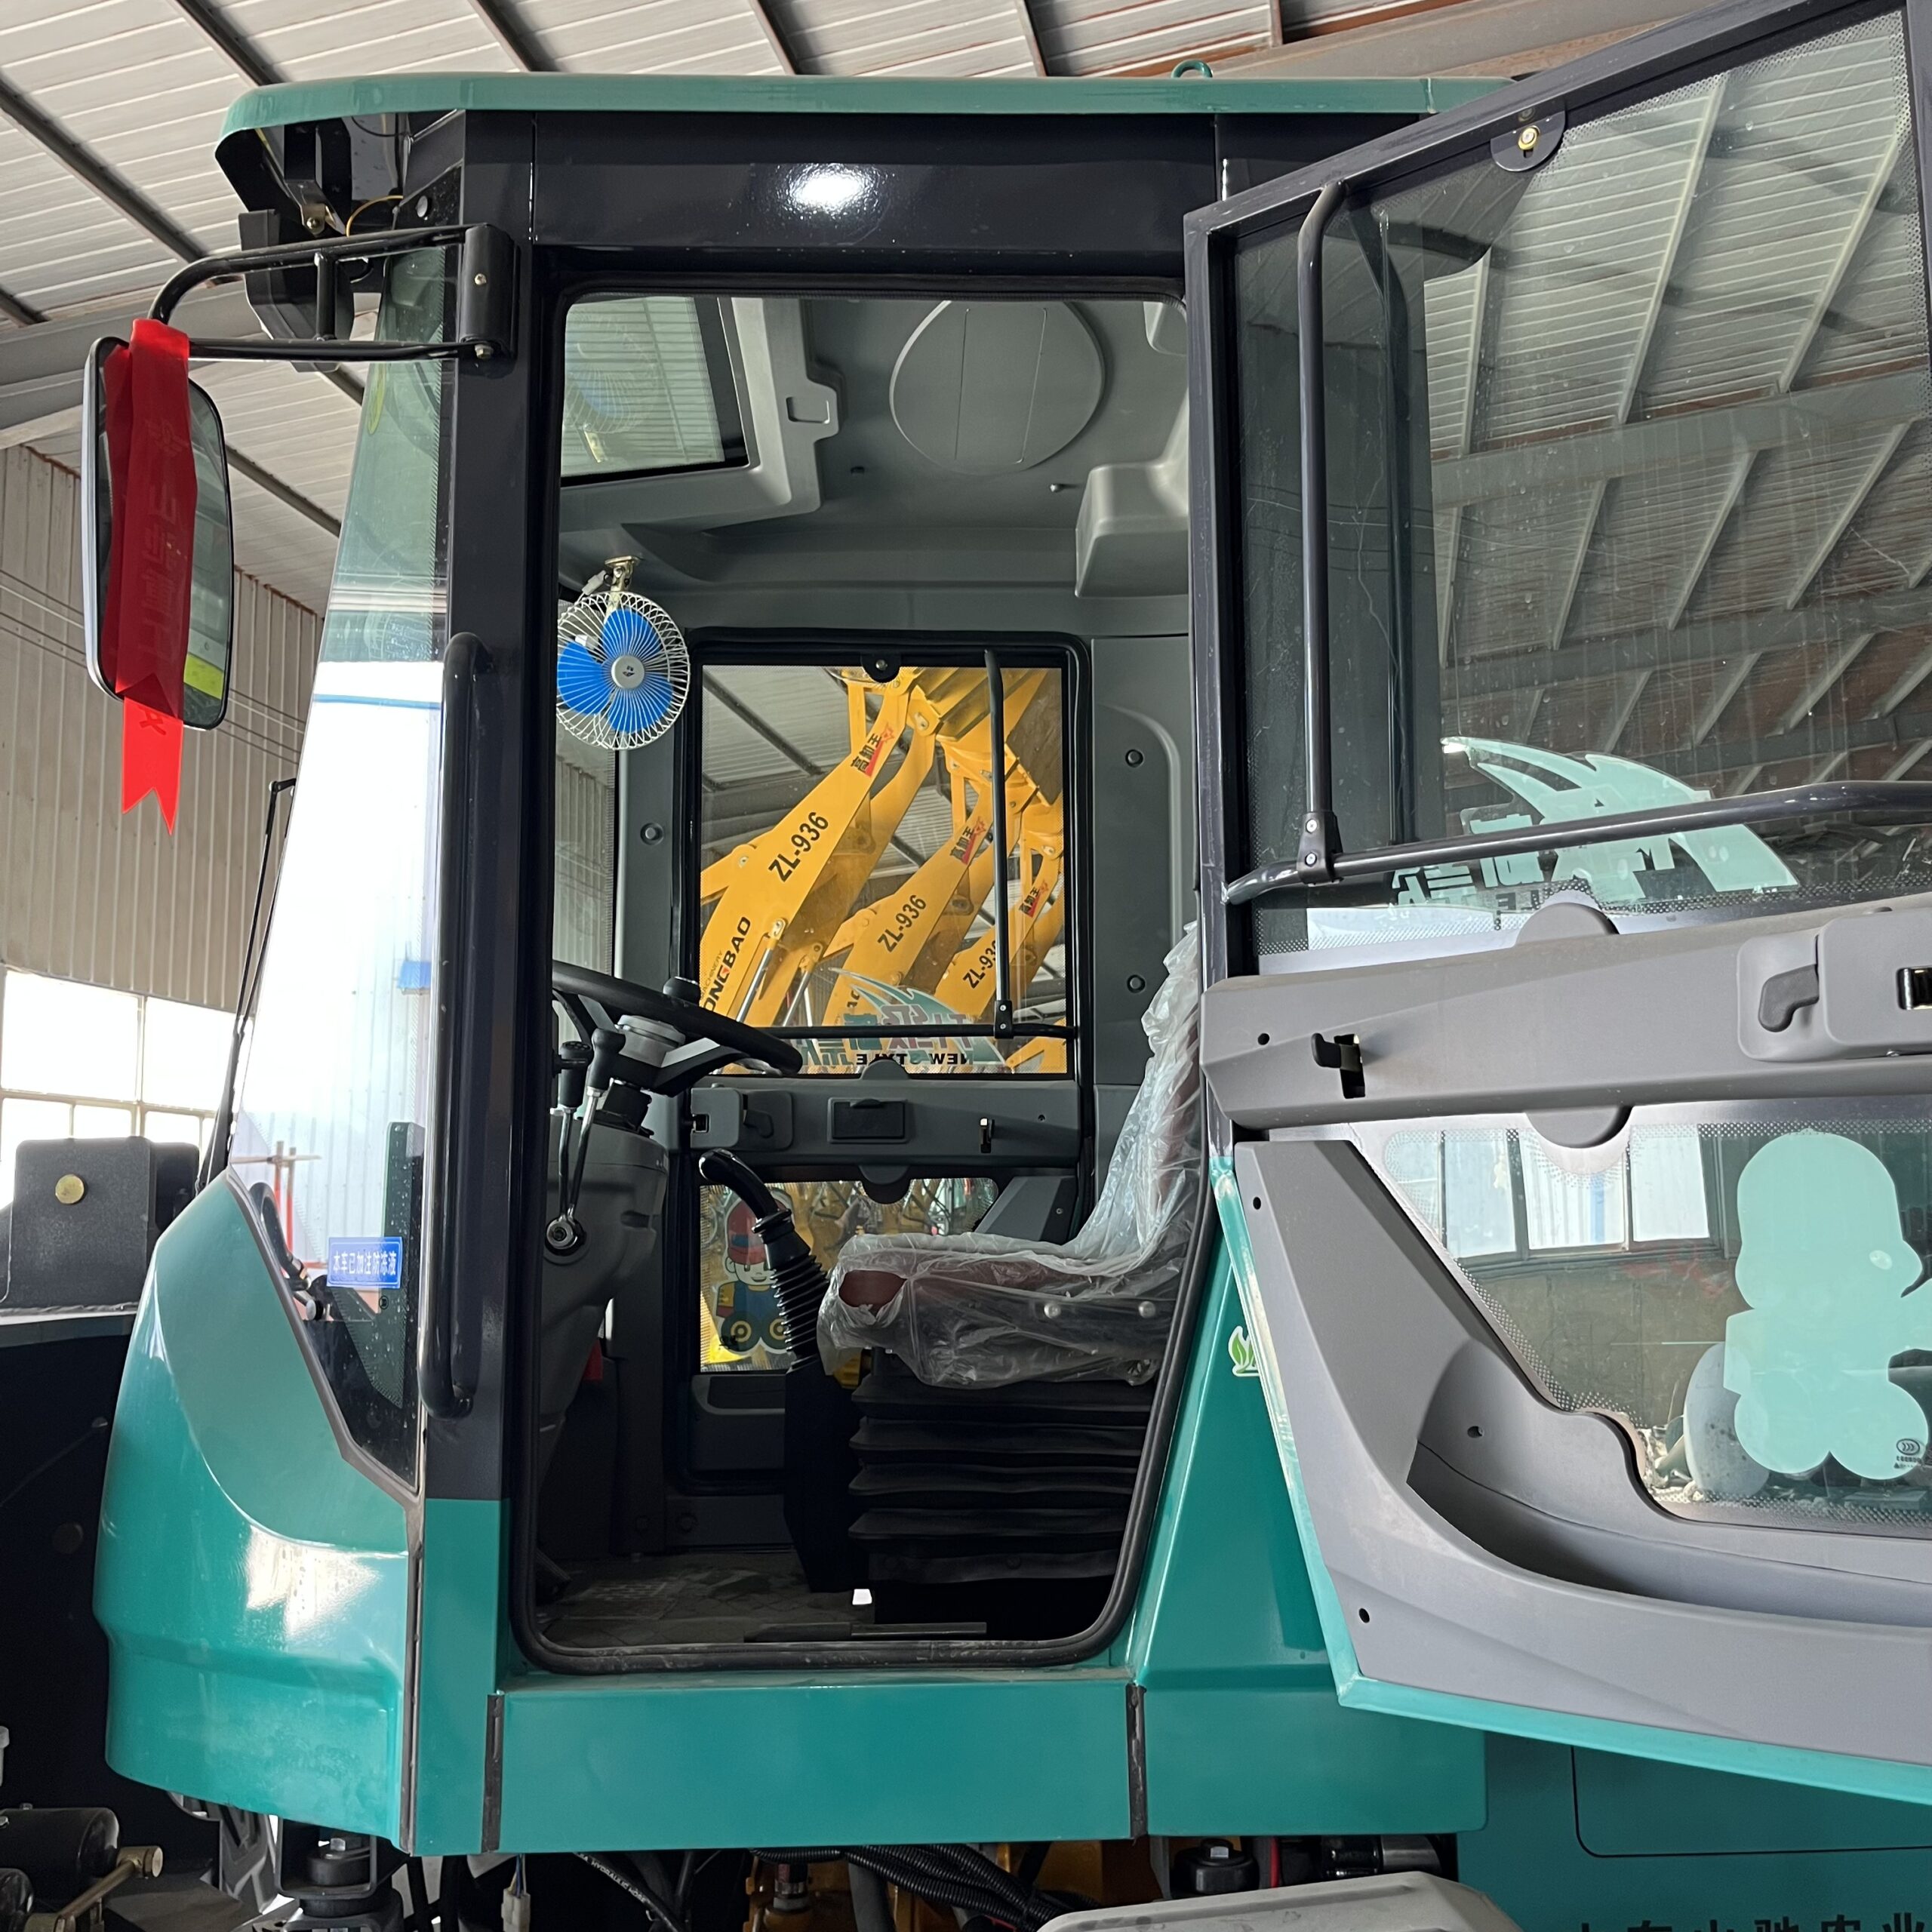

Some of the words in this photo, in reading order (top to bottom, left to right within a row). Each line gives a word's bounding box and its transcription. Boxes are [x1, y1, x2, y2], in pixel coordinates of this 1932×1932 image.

[768, 811, 829, 882] ZL-936
[877, 894, 927, 952] ZL-936
[333, 1250, 397, 1276] 本车已加注防冻液
